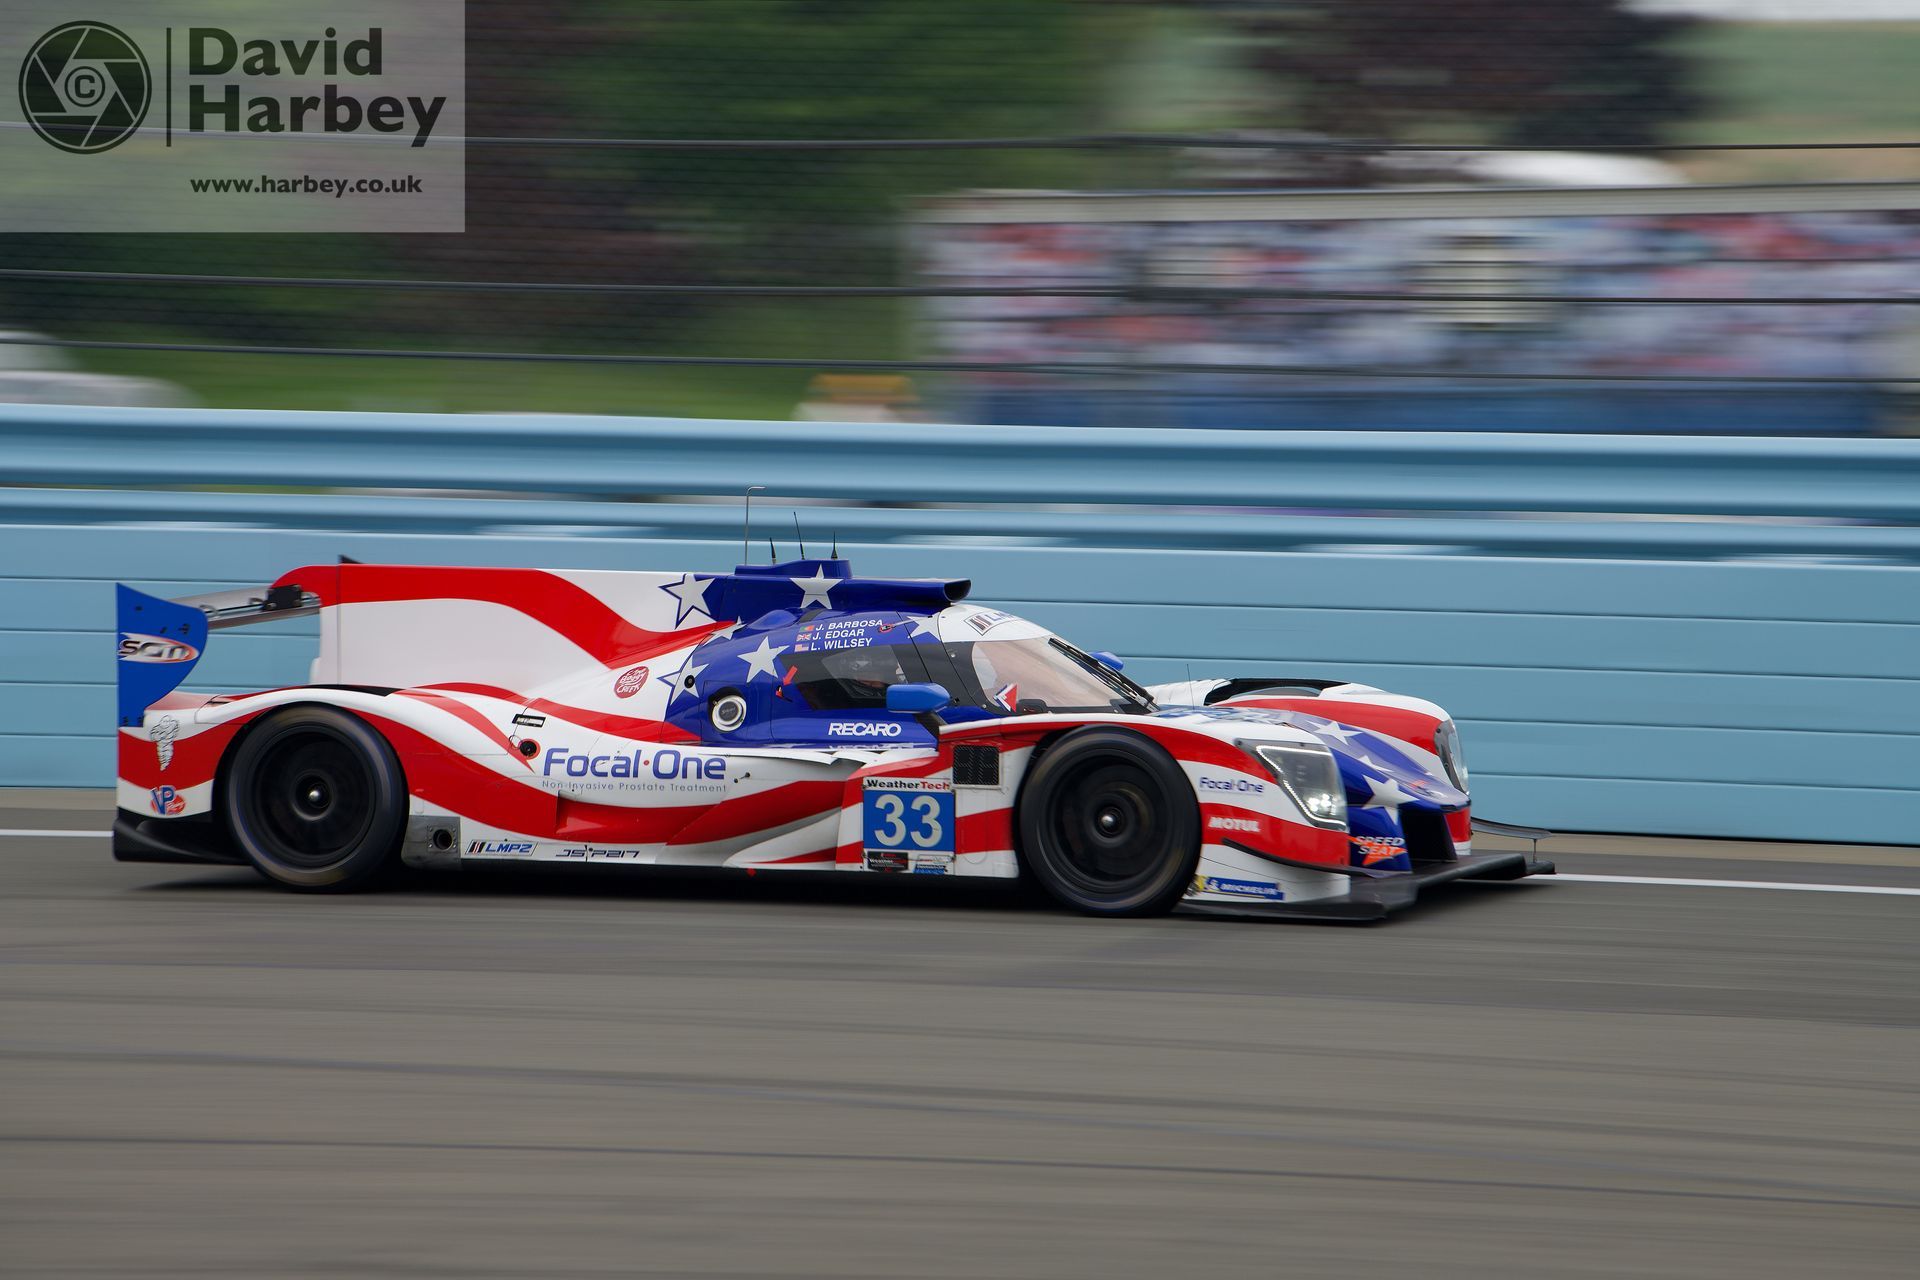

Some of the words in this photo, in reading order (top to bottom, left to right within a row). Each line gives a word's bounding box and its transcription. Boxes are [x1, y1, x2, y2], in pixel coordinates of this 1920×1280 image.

[828, 619, 883, 630] BARBOSA
[825, 628, 865, 639] EDGAR
[824, 637, 873, 650] WILLSEY
[828, 722, 902, 737] RECARO
[619, 782, 665, 791] Prostate
[670, 783, 727, 793] Treatment
[150, 785, 176, 816] VP
[874, 793, 943, 848] 33
[1356, 835, 1406, 847] SPEED
[485, 843, 533, 854] LMP2
